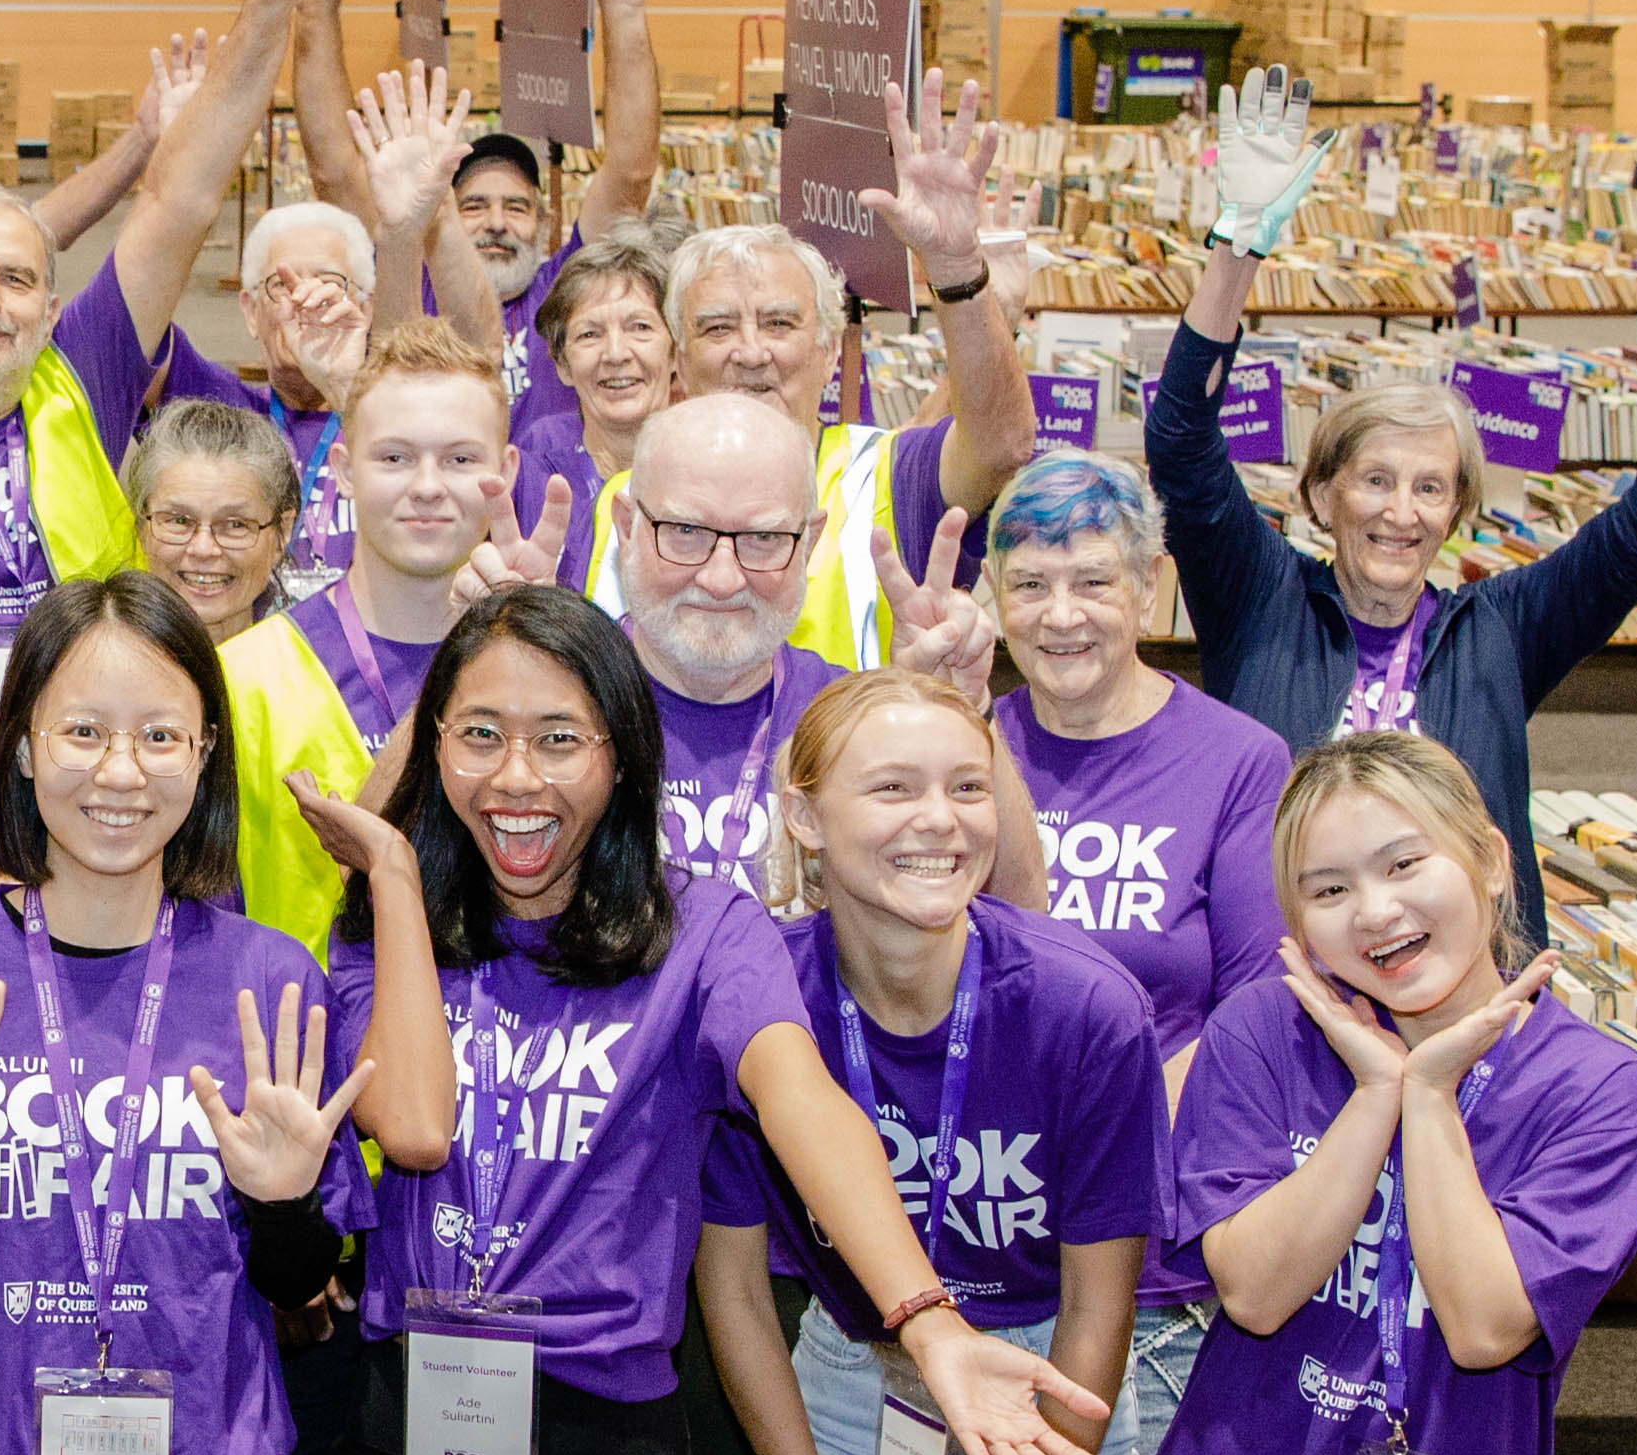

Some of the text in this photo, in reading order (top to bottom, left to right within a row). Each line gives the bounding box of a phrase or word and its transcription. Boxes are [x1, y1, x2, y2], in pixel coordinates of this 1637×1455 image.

[835, 48, 891, 98] HUMOUR
[801, 178, 875, 238] SOCIOLOGY
[1228, 365, 1269, 386] BOOK
[1050, 384, 1093, 402] BOOK
[1046, 413, 1083, 434] Land
[1468, 407, 1539, 441] Evidence
[952, 991, 965, 1029] UNIVERSITY
[847, 1028, 859, 1067] QUEENSLAND
[854, 1029, 866, 1066] UNIVERSITY
[33, 1152, 223, 1220] FAIR
[36, 1281, 66, 1296] THE
[35, 1297, 55, 1312] OF
[422, 1360, 517, 1378] Student Volunteer
[456, 1396, 481, 1409] Ade
[441, 1410, 496, 1426] Suliartini
